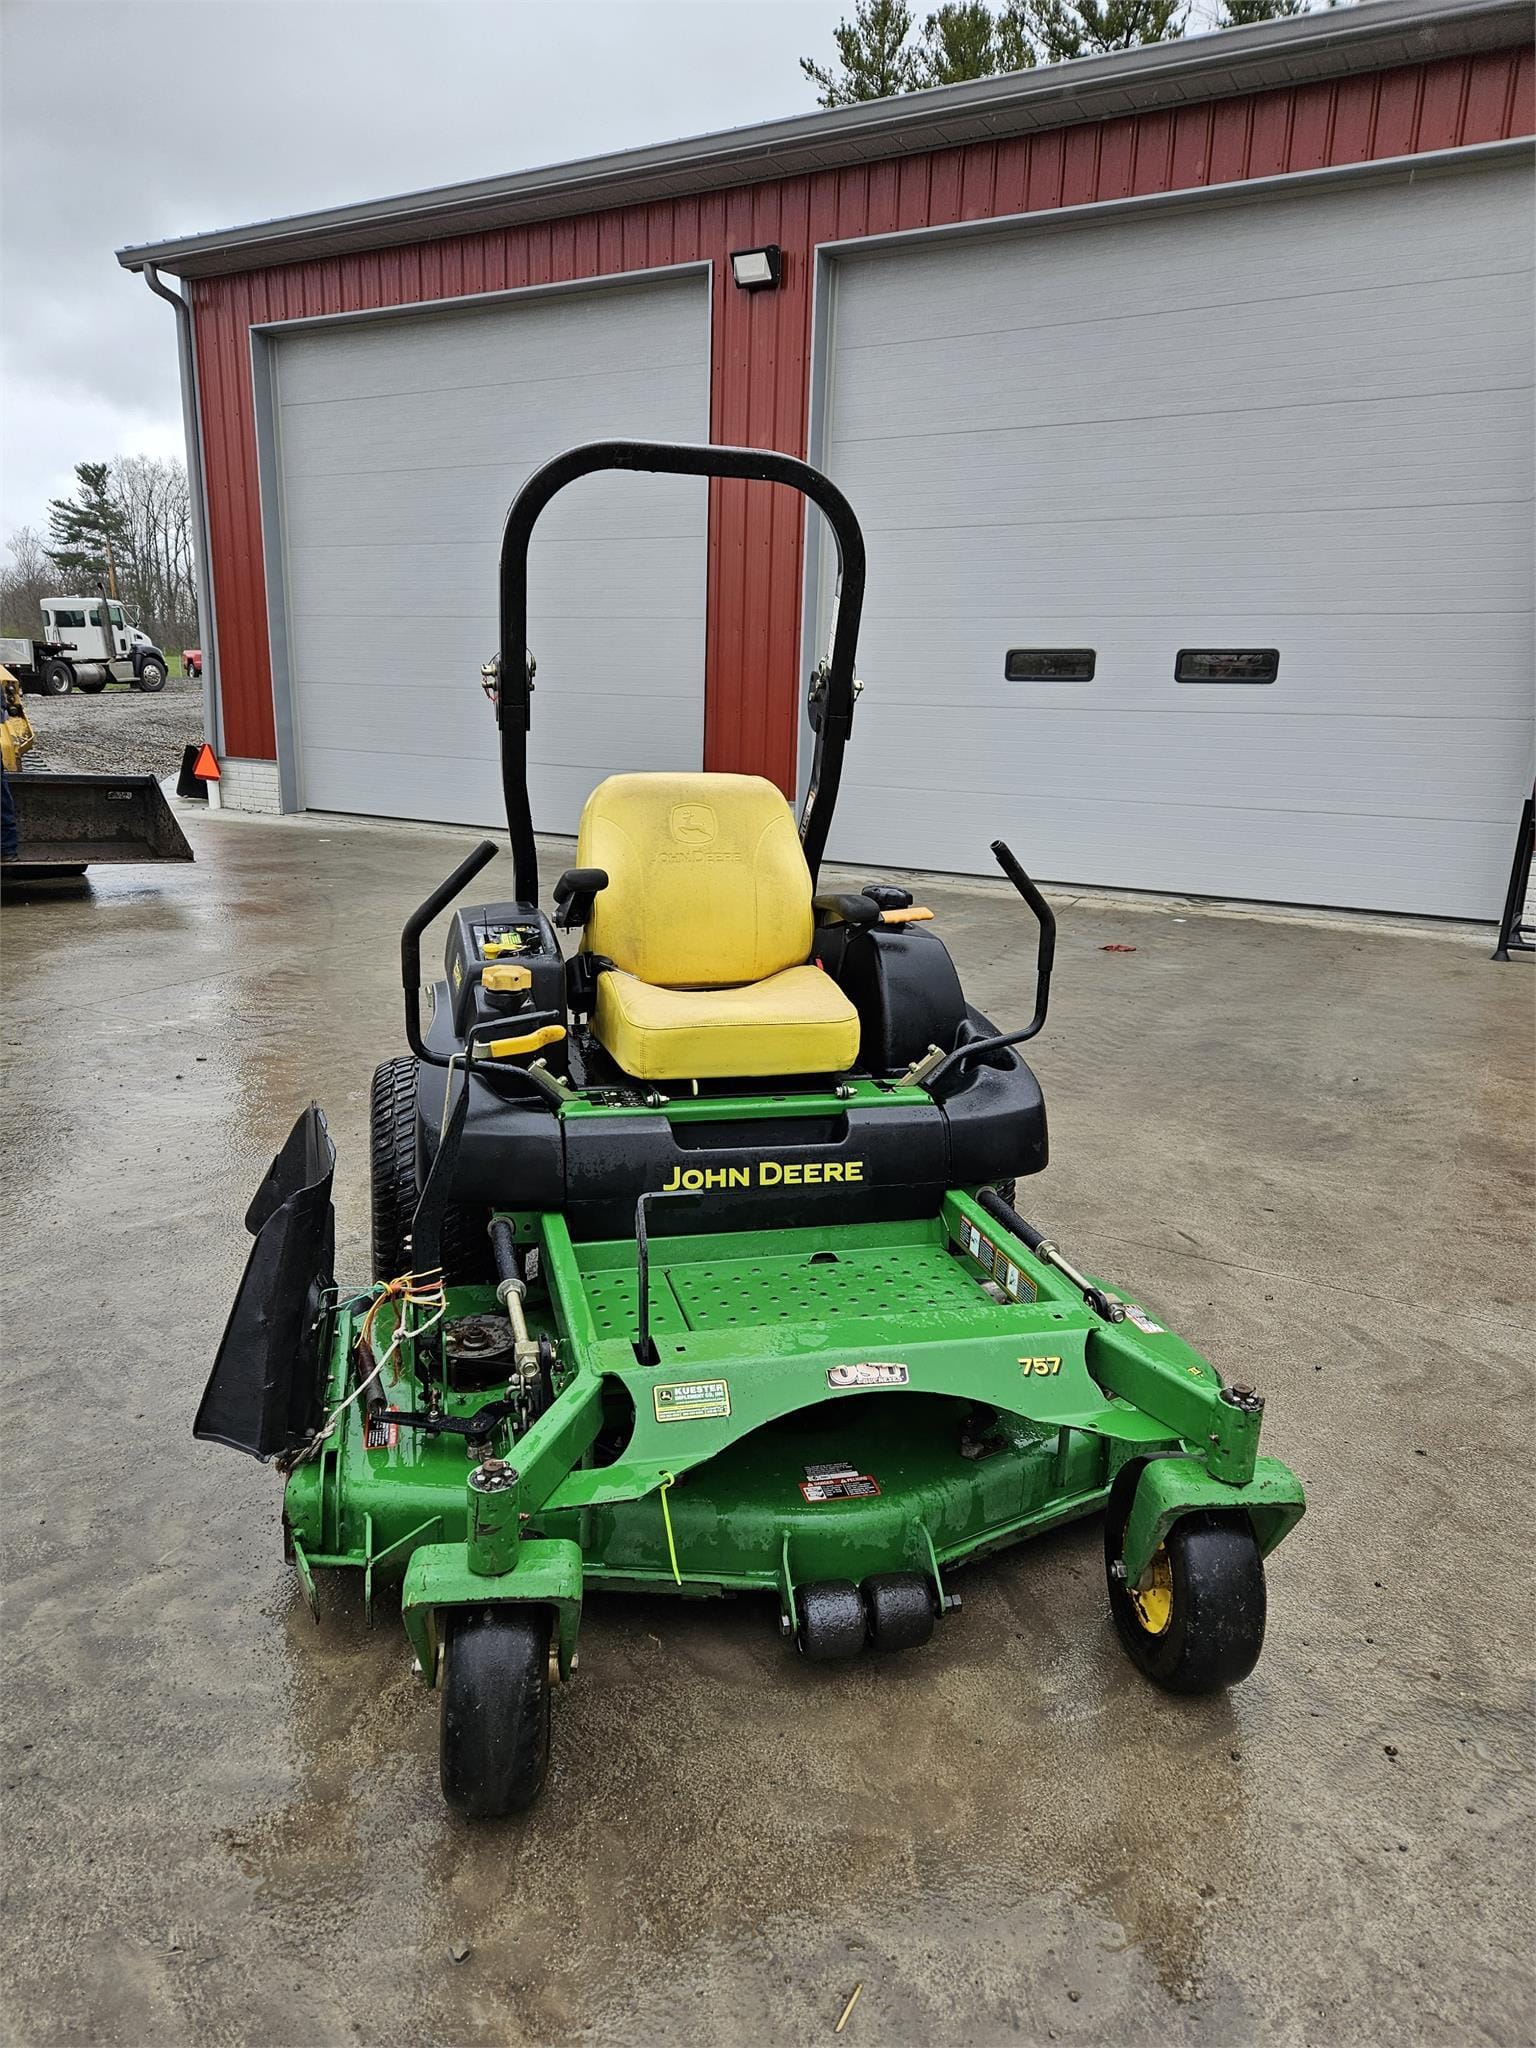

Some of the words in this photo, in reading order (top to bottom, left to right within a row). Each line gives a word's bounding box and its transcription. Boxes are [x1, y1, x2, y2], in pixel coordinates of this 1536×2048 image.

[649, 852, 690, 864] JOHN
[692, 851, 742, 862] DEERE
[663, 1166, 750, 1191] JOHN
[759, 1161, 864, 1185] DEERE
[1017, 1356, 1062, 1377] 757
[674, 1383, 723, 1396] KUESTER
